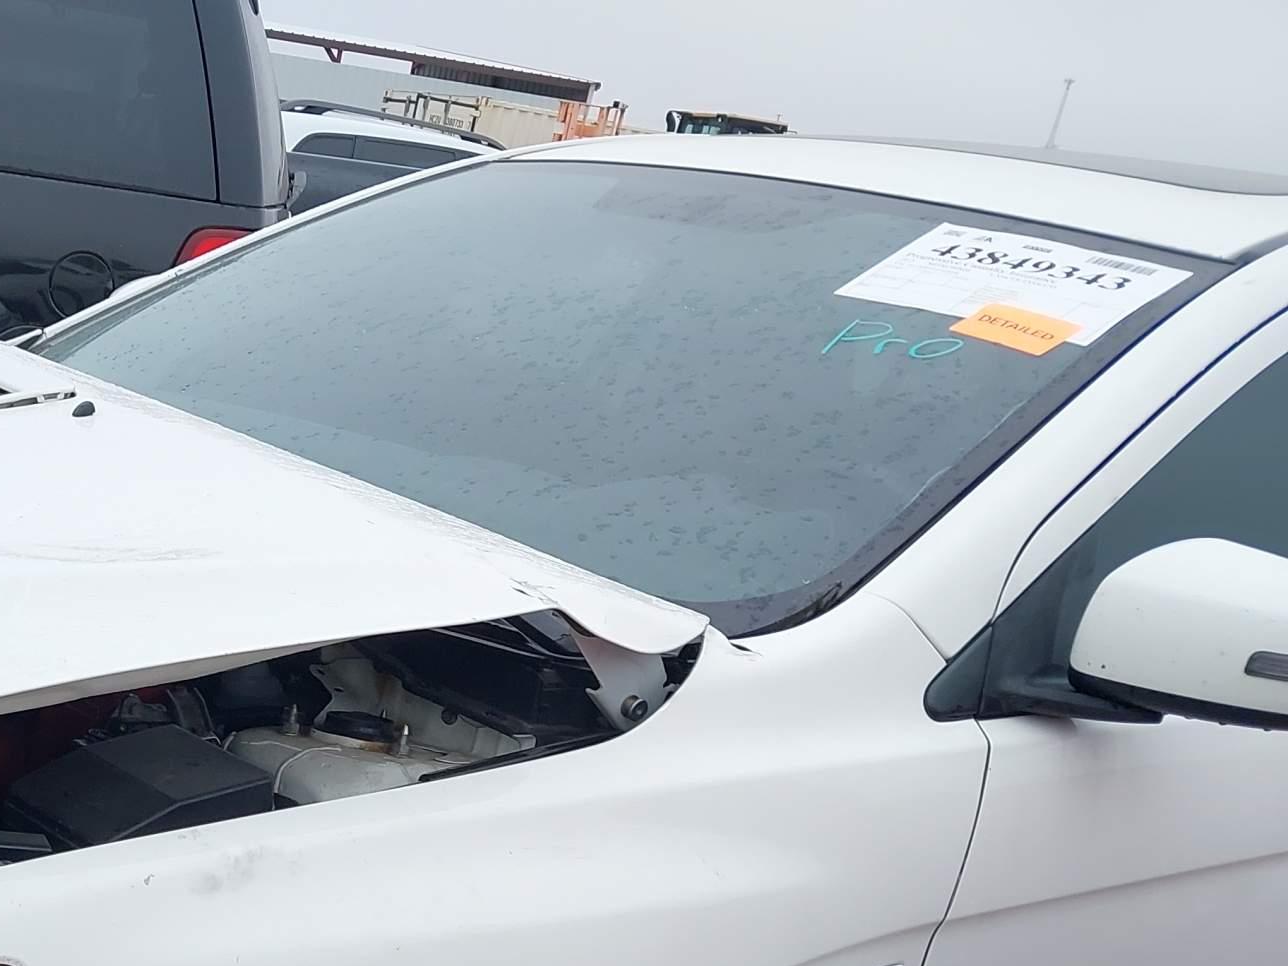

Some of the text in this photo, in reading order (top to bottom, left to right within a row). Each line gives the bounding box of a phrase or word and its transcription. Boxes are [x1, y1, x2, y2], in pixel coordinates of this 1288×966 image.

[931, 244, 1132, 290] 43849343
[820, 319, 965, 360] Pro
[977, 313, 1055, 341] DETAILED
